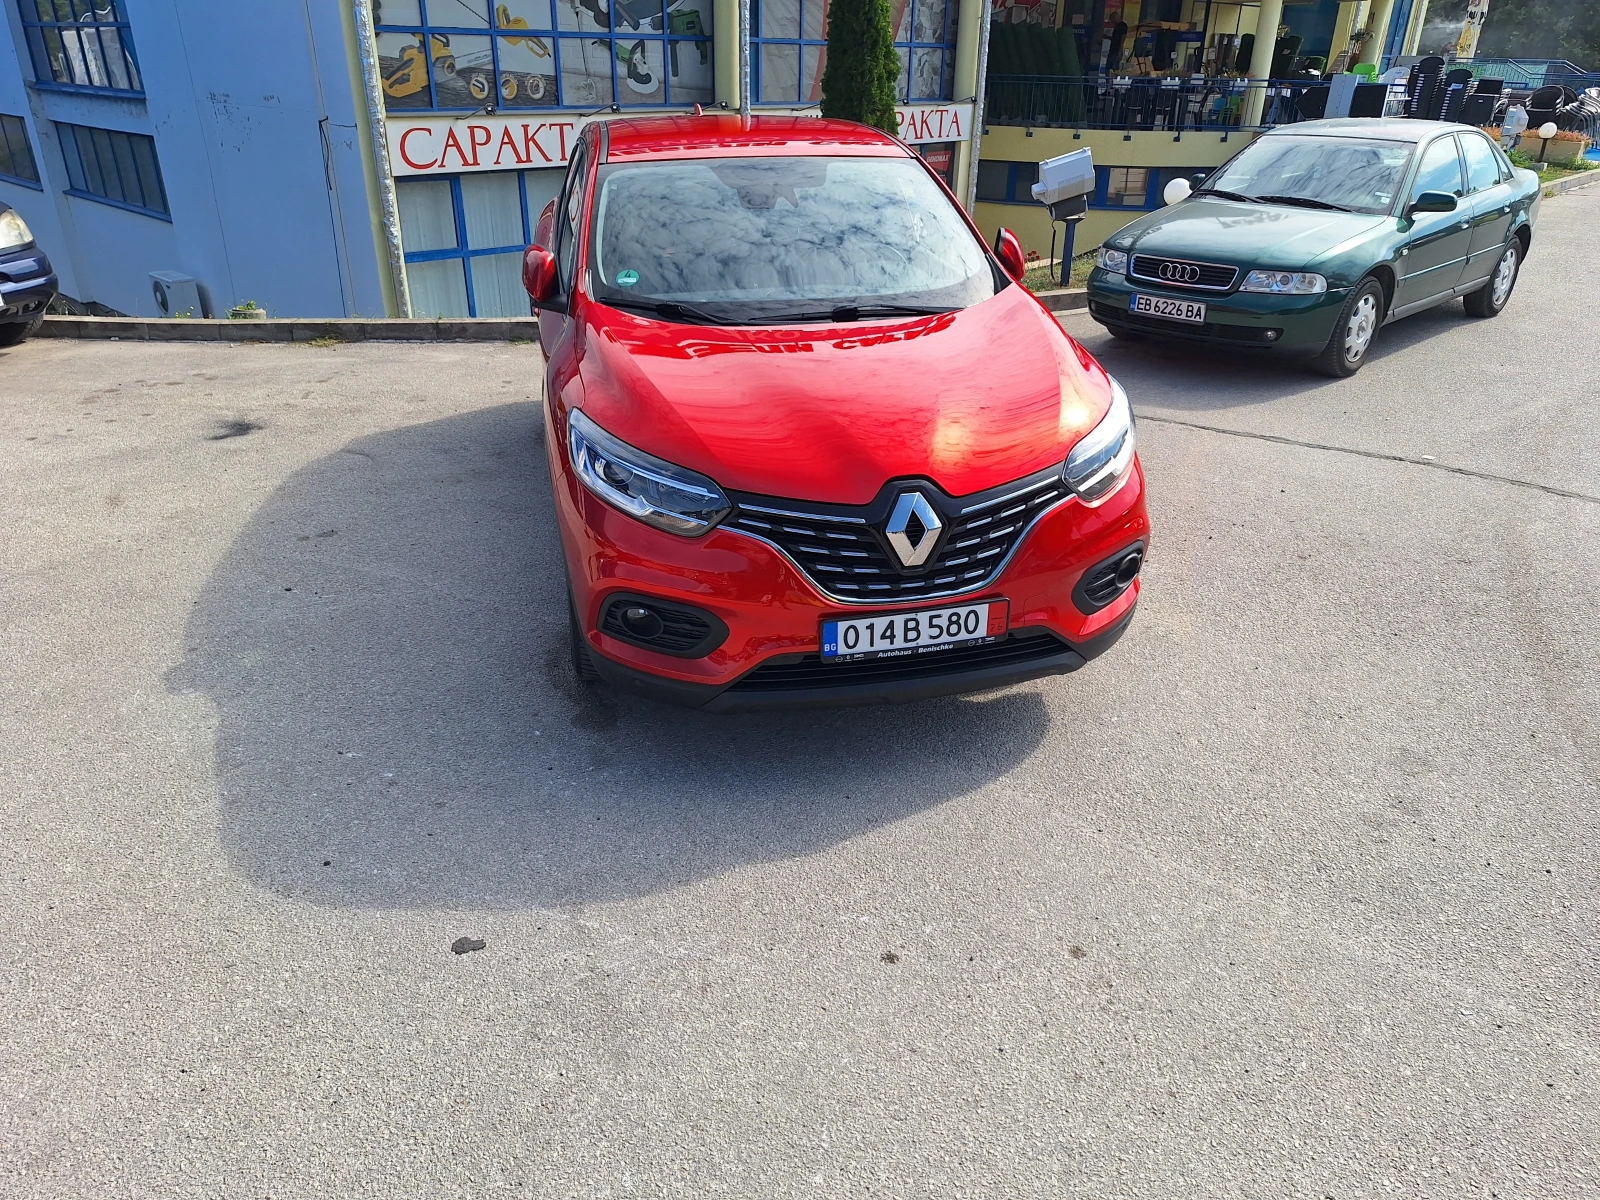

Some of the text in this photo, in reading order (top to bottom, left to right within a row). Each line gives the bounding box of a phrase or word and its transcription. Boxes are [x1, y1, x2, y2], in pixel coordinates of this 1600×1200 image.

[624, 270, 631, 278] 4
[1137, 297, 1202, 320] EB 6226 BA
[824, 643, 837, 652] BG
[877, 648, 912, 659] Autohaus
[918, 643, 954, 654] Benischke
